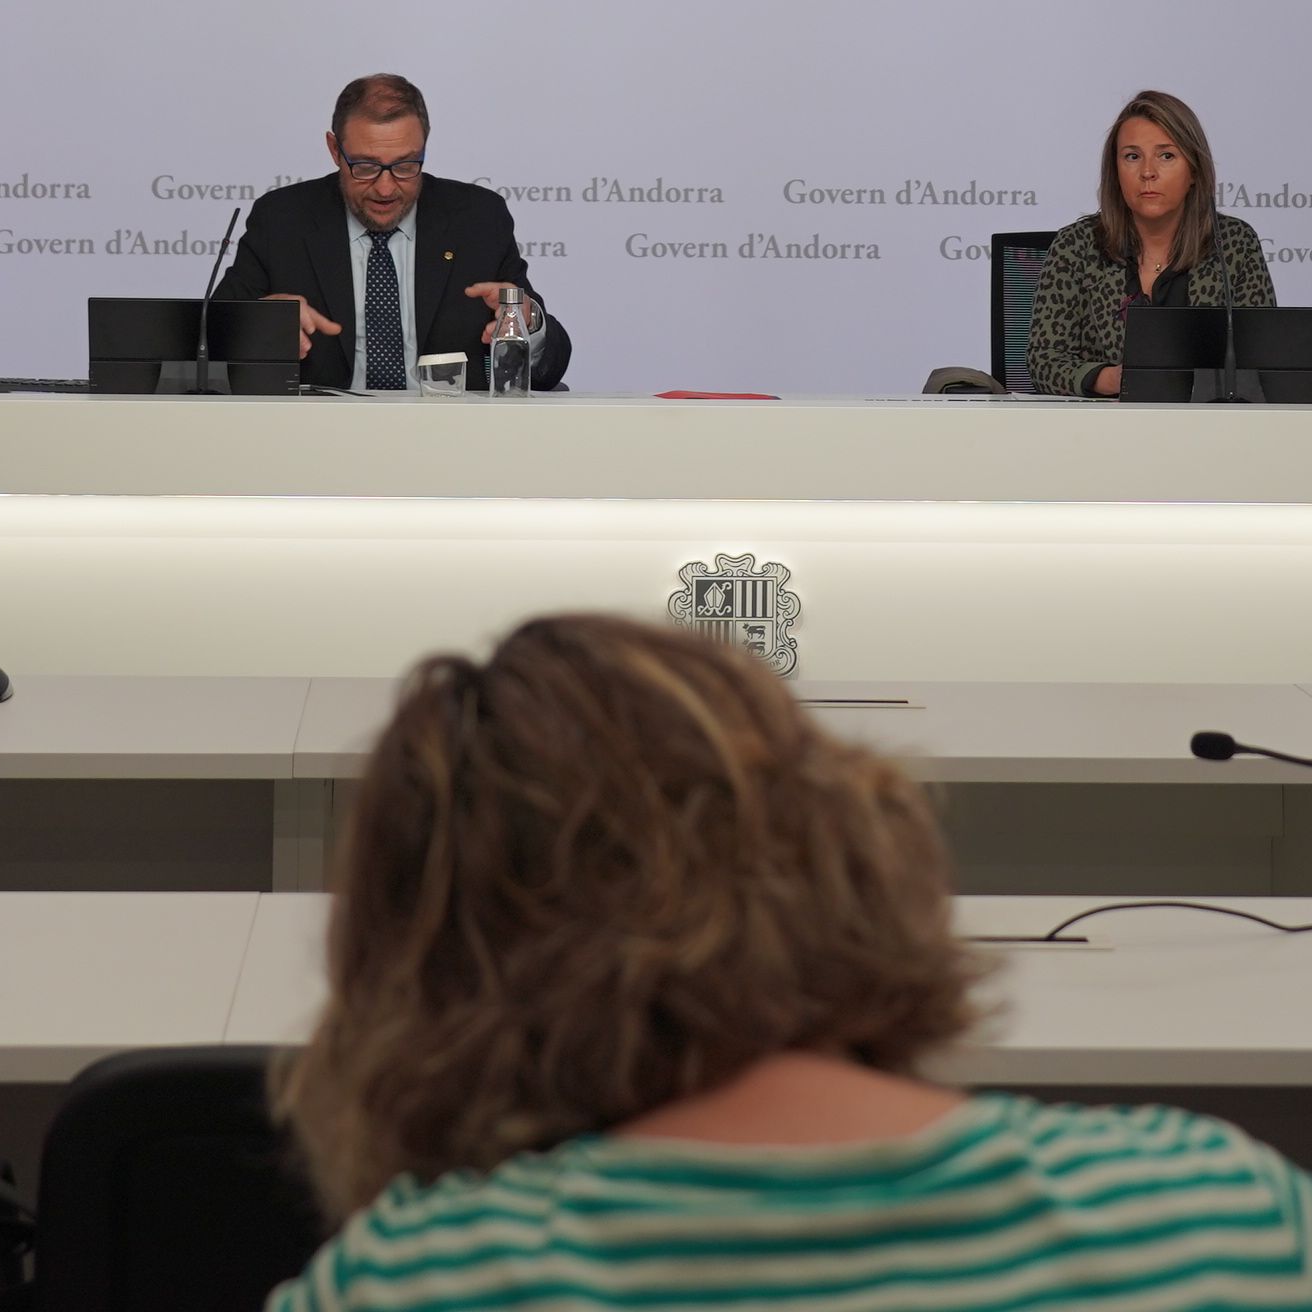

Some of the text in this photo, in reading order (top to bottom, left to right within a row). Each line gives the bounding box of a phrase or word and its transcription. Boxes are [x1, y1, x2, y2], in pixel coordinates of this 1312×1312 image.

[151, 174, 256, 201] Govern
[581, 176, 726, 204] d’Andorra
[782, 178, 1039, 206] Govern d’Andorra
[104, 228, 234, 256] d’Andor
[624, 232, 882, 260] Govern d’Andorra
[939, 235, 991, 261] Gov
